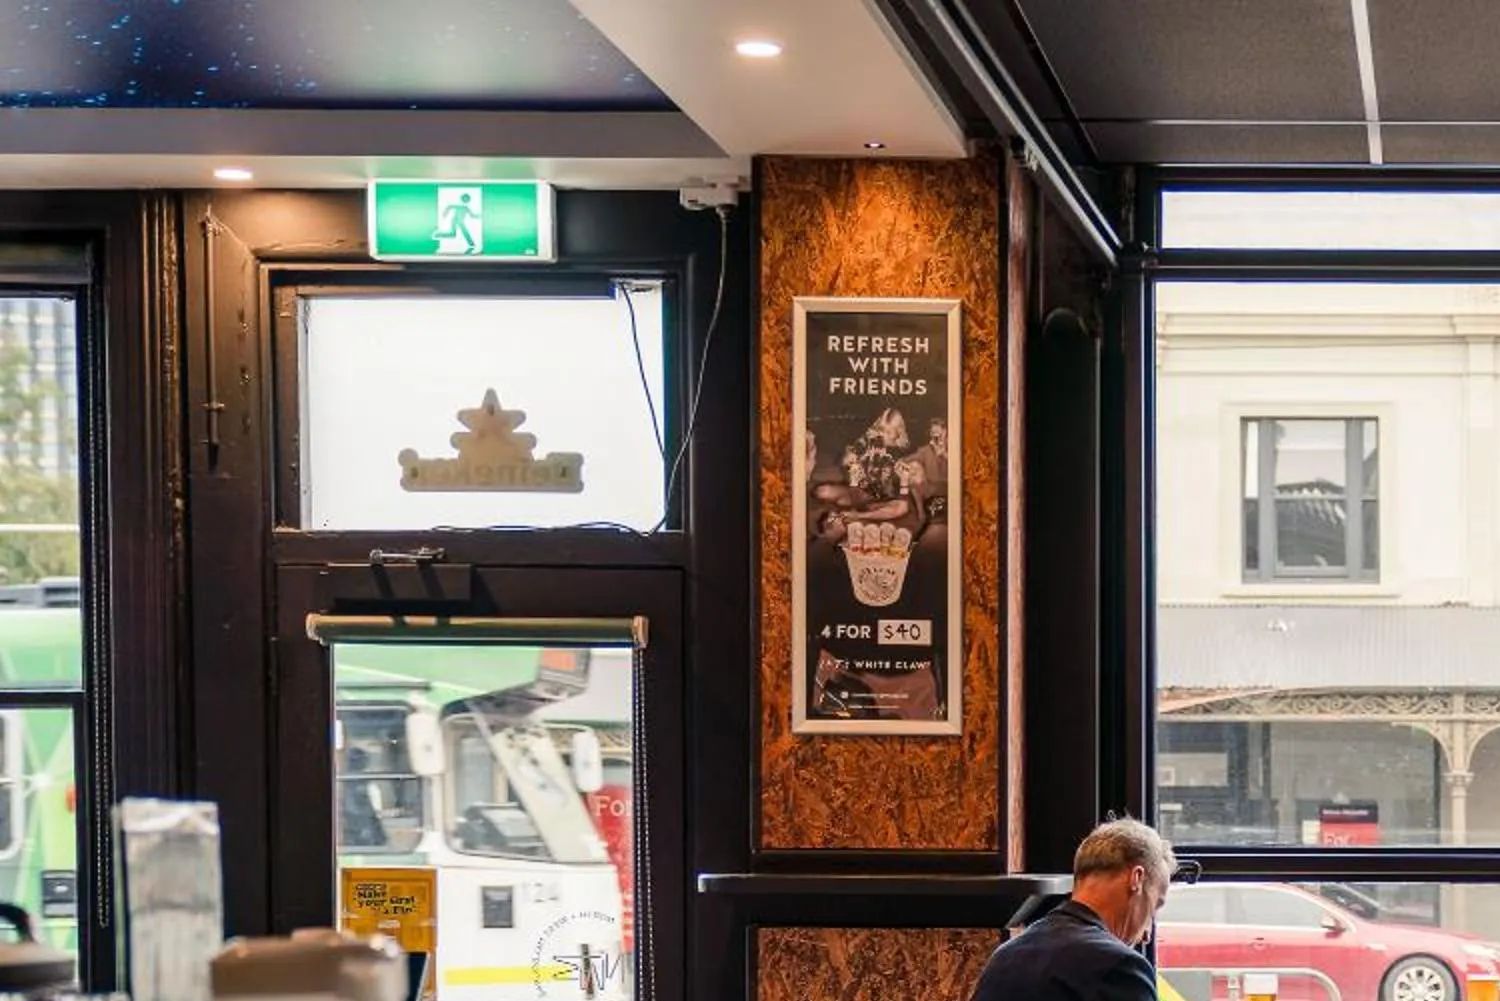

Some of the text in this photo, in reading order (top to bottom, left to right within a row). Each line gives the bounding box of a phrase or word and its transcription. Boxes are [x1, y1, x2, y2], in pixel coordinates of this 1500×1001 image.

[828, 335, 929, 353] REFRESH
[847, 356, 910, 375] WITH
[829, 377, 928, 396] FRIENDS
[821, 624, 872, 639] 4 FOR
[883, 623, 922, 641] $40
[854, 661, 891, 669] WHITE
